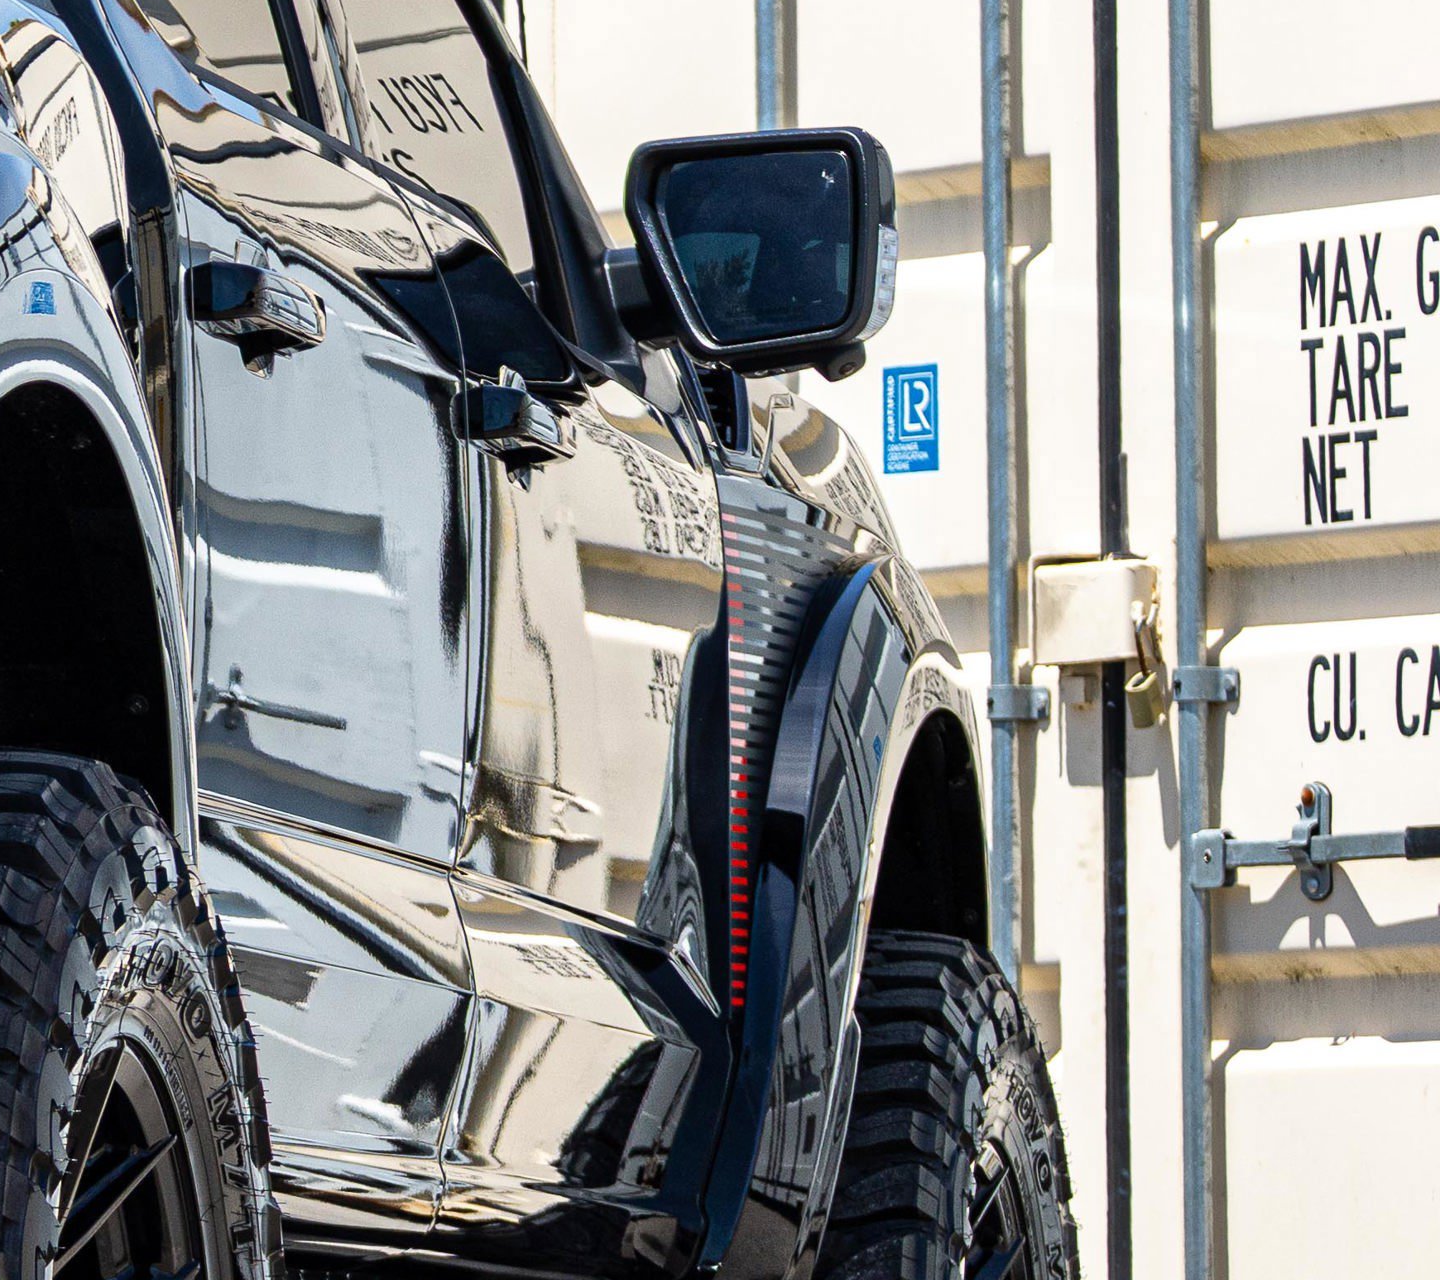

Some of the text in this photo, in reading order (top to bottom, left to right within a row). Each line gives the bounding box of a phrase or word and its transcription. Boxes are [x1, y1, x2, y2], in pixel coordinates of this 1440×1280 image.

[1300, 233, 1392, 330] MAX.
[904, 381, 930, 432] LR
[1300, 328, 1409, 427] TARE
[1302, 431, 1378, 525] NET
[1308, 653, 1366, 743] CU.
[1005, 1069, 1055, 1197] TOYO
